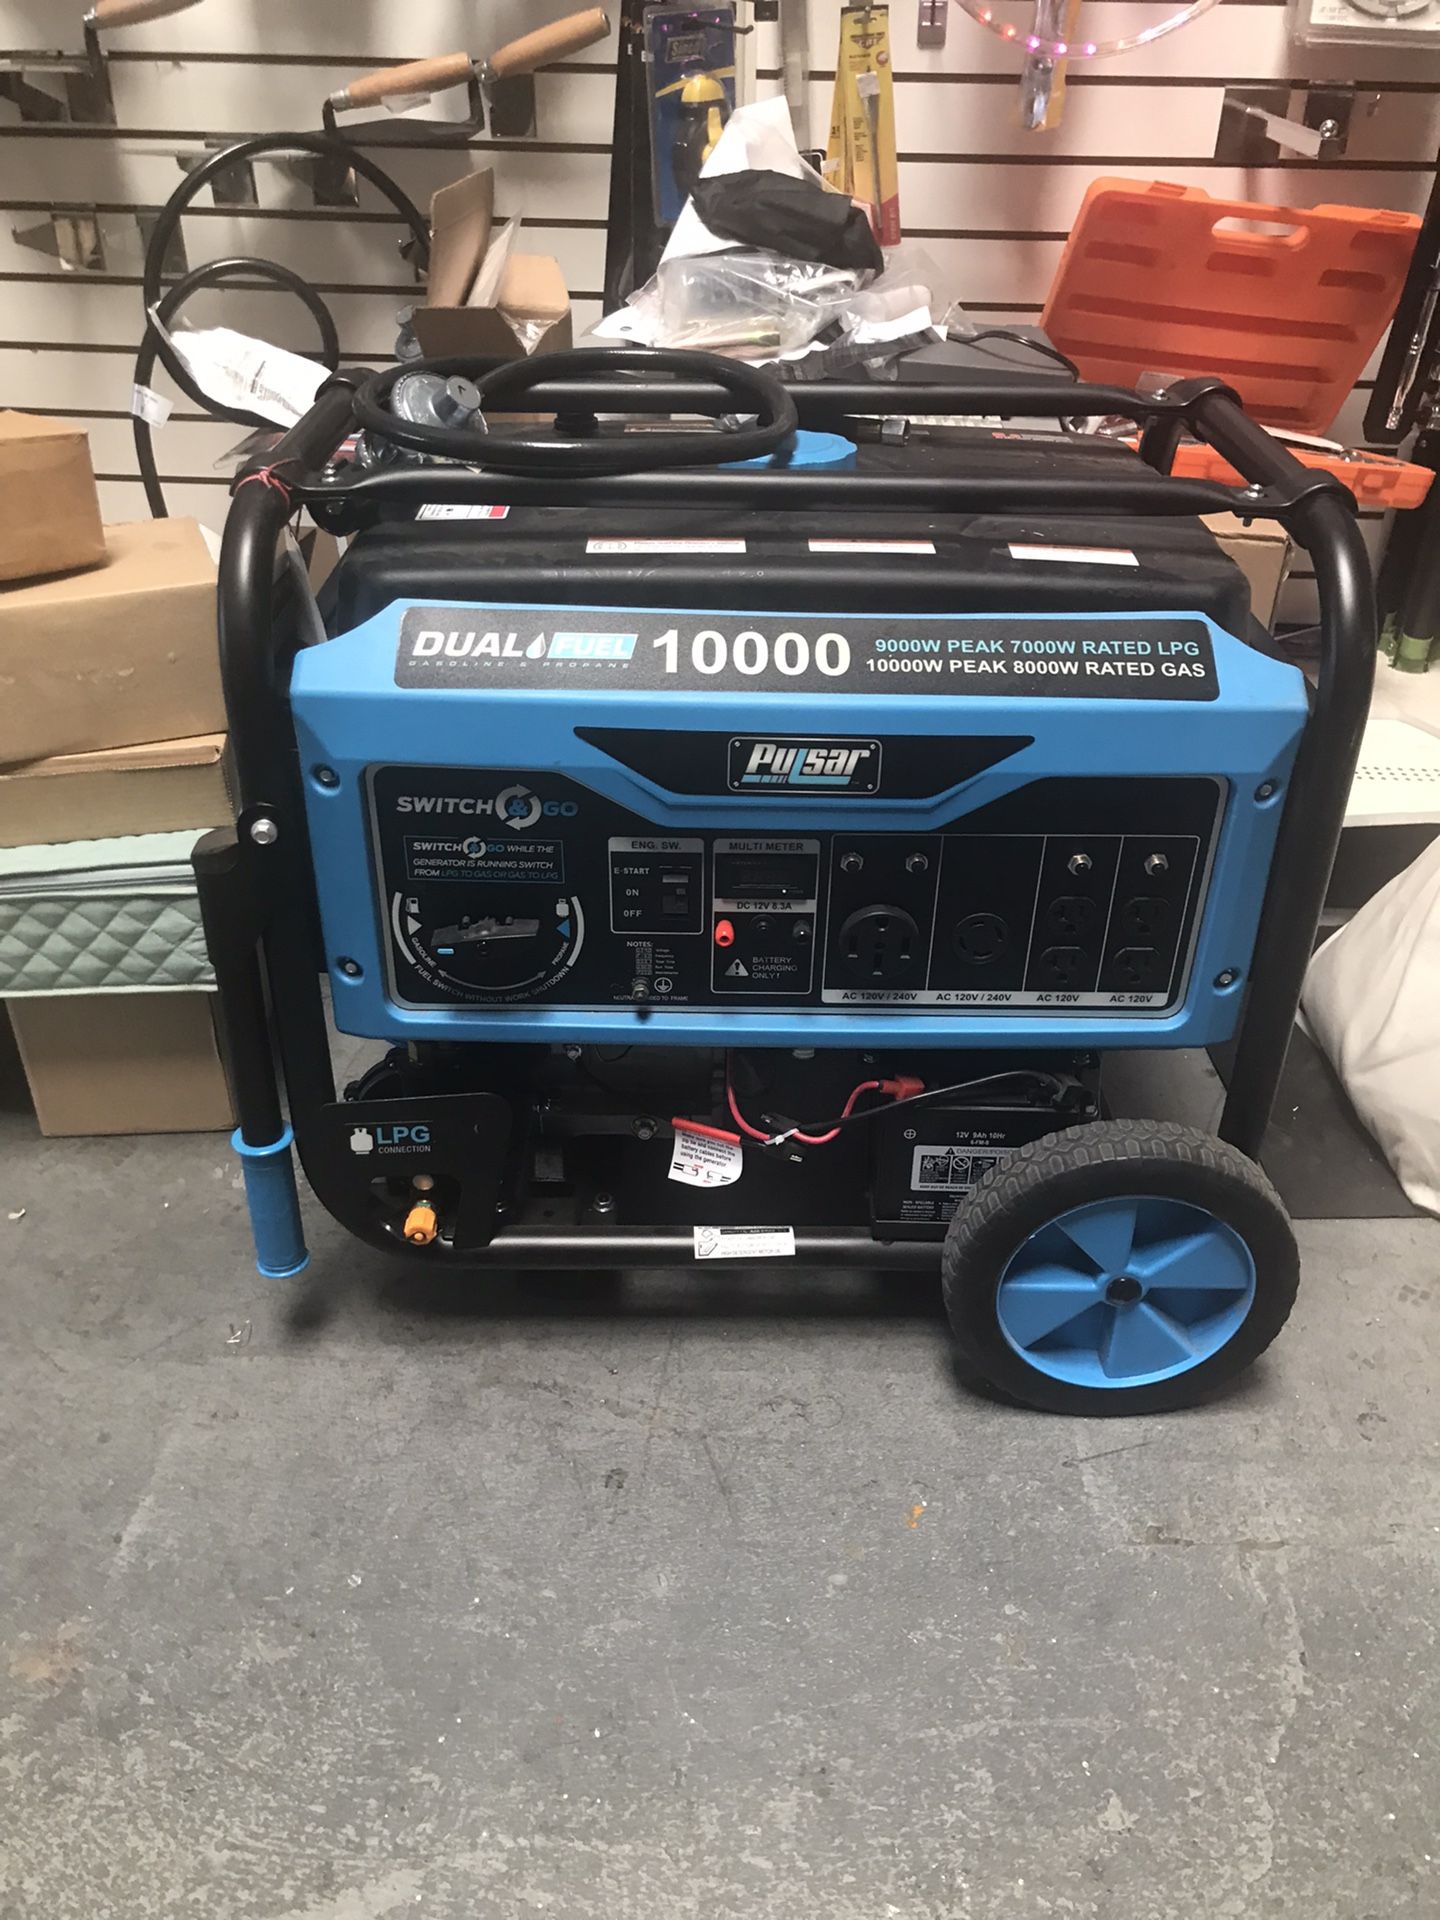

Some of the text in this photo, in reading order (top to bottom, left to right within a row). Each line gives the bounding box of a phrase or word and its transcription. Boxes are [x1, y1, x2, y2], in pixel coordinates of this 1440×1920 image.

[412, 631, 629, 658] DUAL FUEL
[875, 639, 1200, 657] 9000W PEAK 7000W RATED LPG
[652, 628, 852, 677] 10000
[408, 660, 504, 668] GASOLINE
[543, 661, 630, 669] PROPANE
[866, 658, 1206, 678] 10000W PEAK 8000W RATED GAS
[744, 743, 871, 785] Pulsar
[396, 796, 580, 817] SWITCH & GO
[412, 841, 462, 852] SWITCH
[486, 843, 505, 853] GO
[506, 844, 536, 854] WHILE
[537, 845, 555, 854] THE
[631, 840, 682, 850] ENG. SW.
[728, 841, 804, 851] MULTI METER
[412, 858, 553, 870] GENERATOR IS RUNNING SWITCH
[414, 868, 440, 878] FROM
[474, 870, 492, 879] GAS
[613, 866, 650, 875] E-START
[736, 901, 750, 910] DC
[754, 901, 770, 910] 12V
[623, 909, 643, 918] OFF
[411, 936, 438, 969] GASOLINE
[752, 956, 792, 964] BATTERY
[752, 964, 798, 972] CHARGING
[414, 964, 570, 1003] FUEL SWITCH WITHOUT WORK SHUTDOWN
[842, 992, 857, 1001] AC
[860, 992, 885, 1001] 120V
[892, 992, 918, 1002] 240V
[936, 993, 953, 1002] AC
[956, 993, 979, 1002] 120V
[985, 993, 1012, 1003] 240V
[1036, 994, 1080, 1003] AC 120V
[1109, 994, 1154, 1004] AC 120V
[376, 1125, 431, 1145] LPG
[955, 1131, 1006, 1140] 12V 9Ah 10Hr
[378, 1145, 431, 1154] CONNECTION
[681, 1143, 732, 1162] battery cables before
[680, 1152, 694, 1160] using
[703, 1157, 728, 1167] generator
